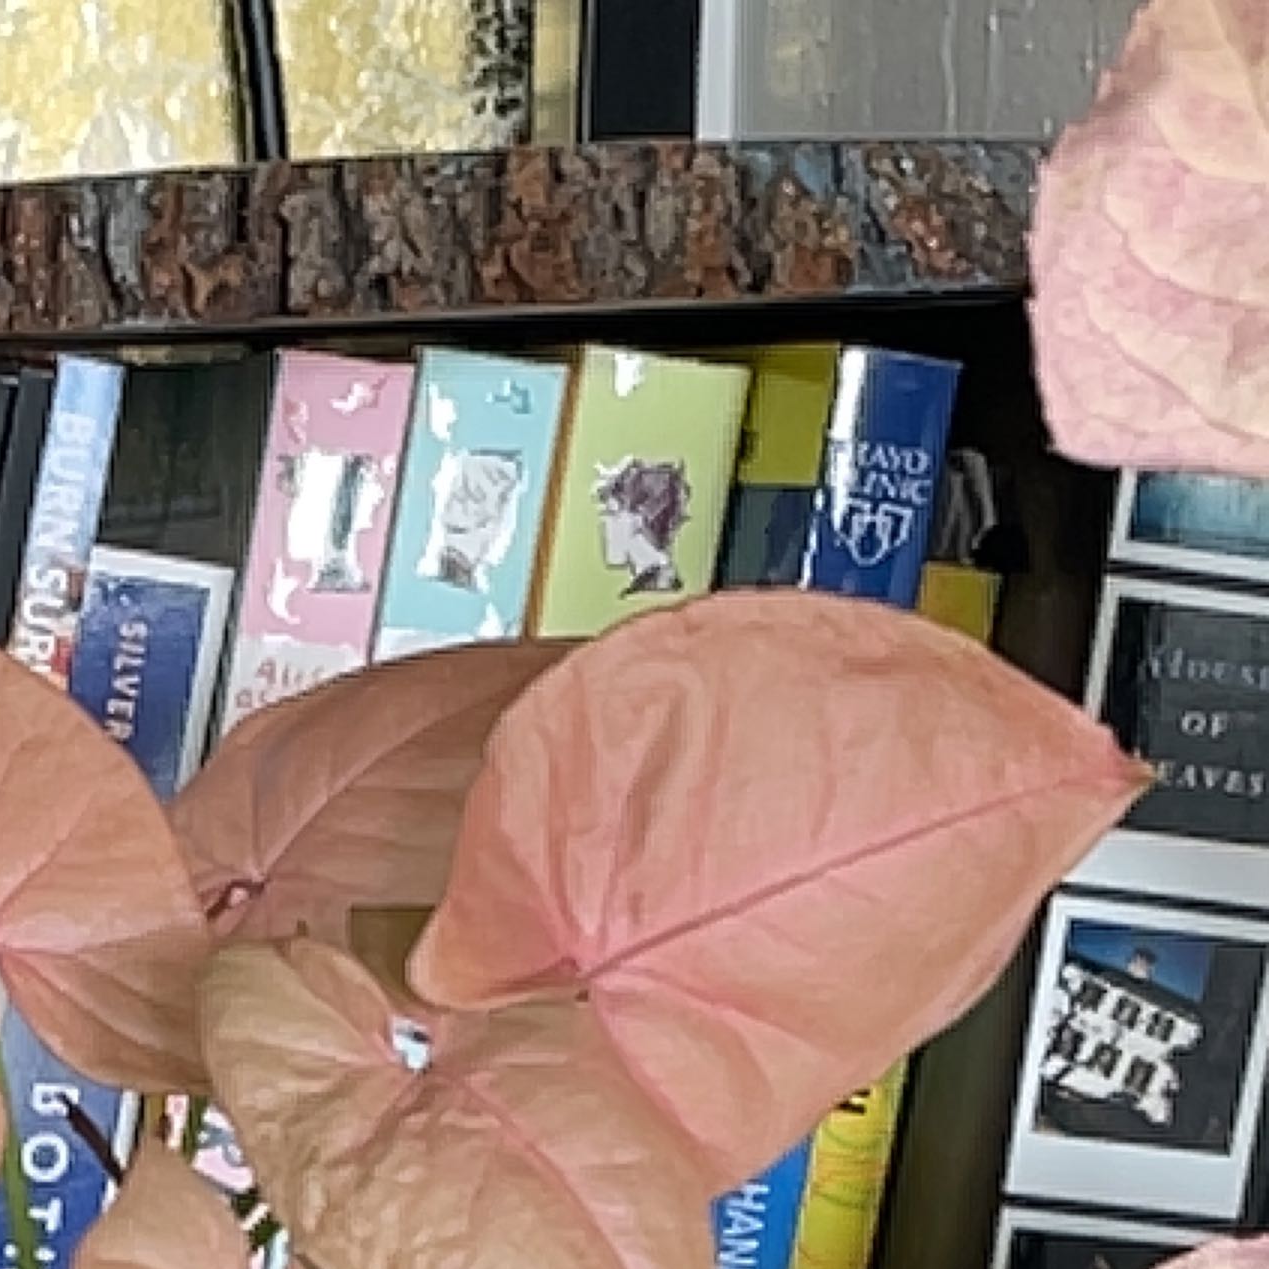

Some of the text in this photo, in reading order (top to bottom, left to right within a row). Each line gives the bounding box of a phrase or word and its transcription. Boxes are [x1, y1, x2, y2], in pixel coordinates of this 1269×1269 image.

[104, 621, 149, 743] SILVER
[1181, 709, 1229, 739] OF
[1157, 760, 1265, 798] EAVES
